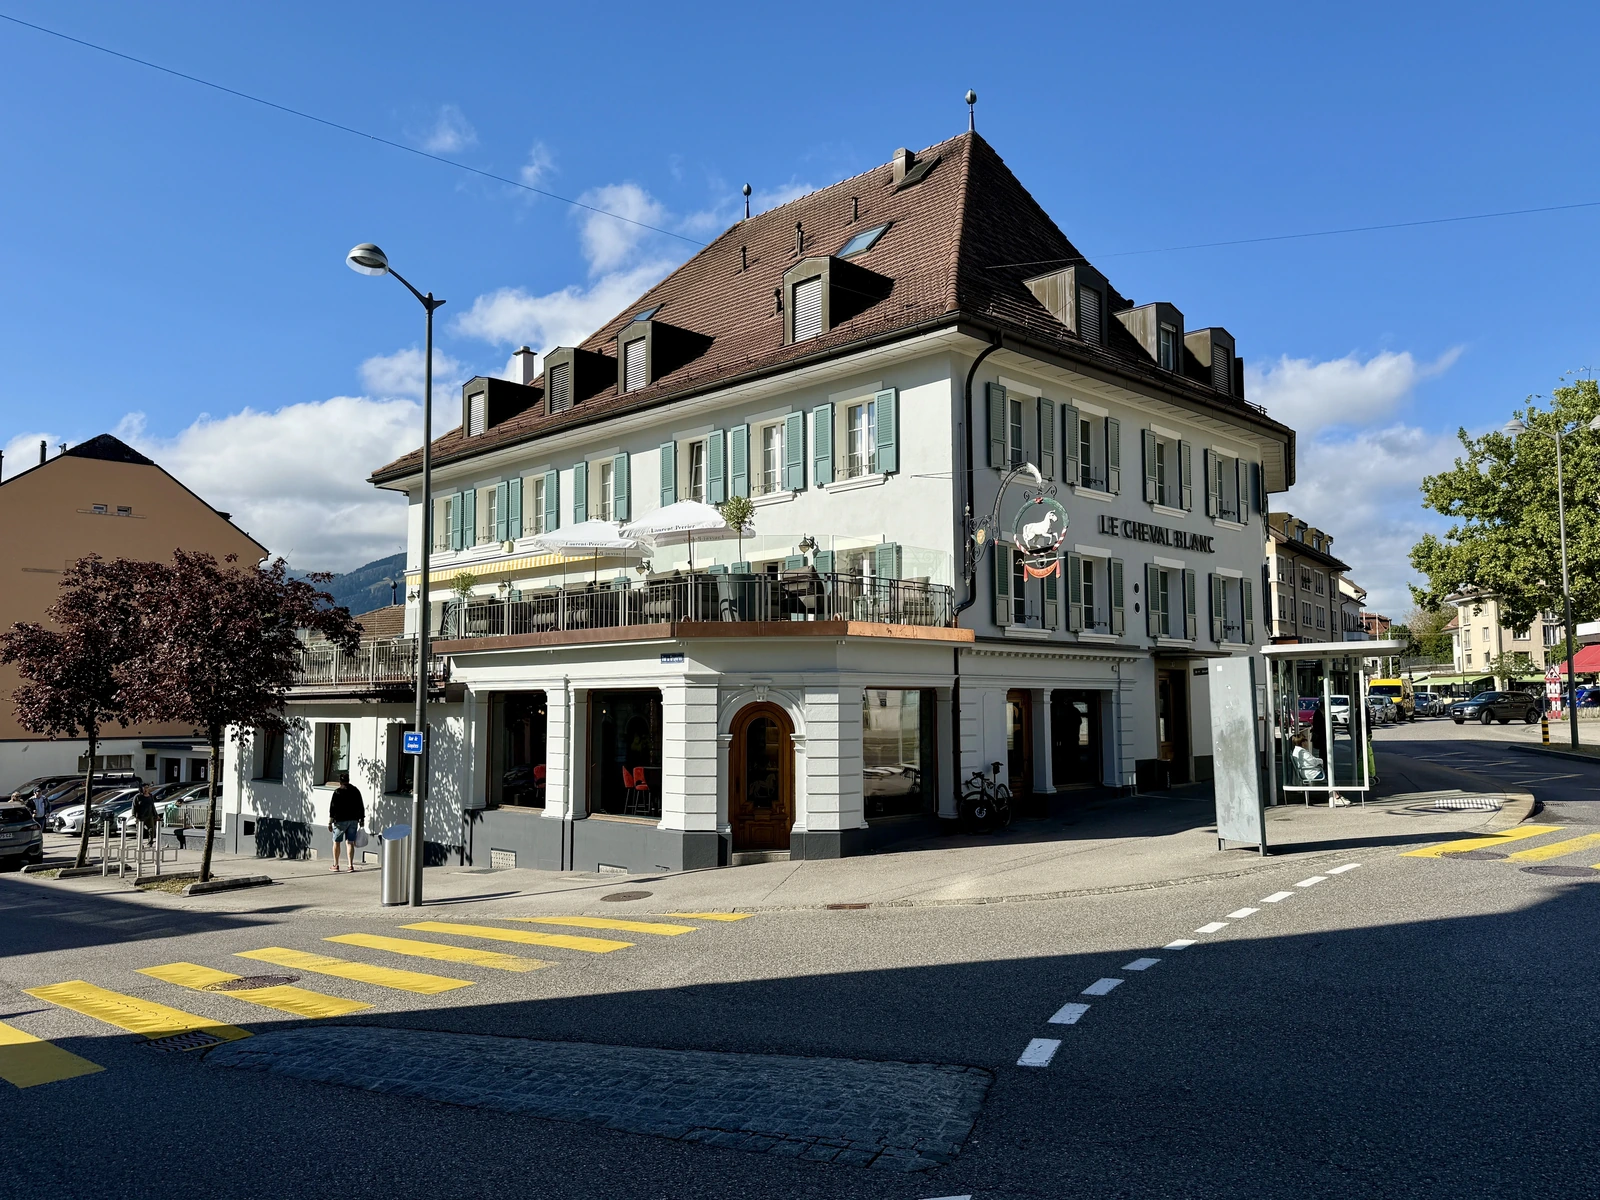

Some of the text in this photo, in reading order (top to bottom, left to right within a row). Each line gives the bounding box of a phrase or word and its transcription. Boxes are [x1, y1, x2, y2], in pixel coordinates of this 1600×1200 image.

[1100, 515, 1215, 553] LE CHEVAL BLANC
